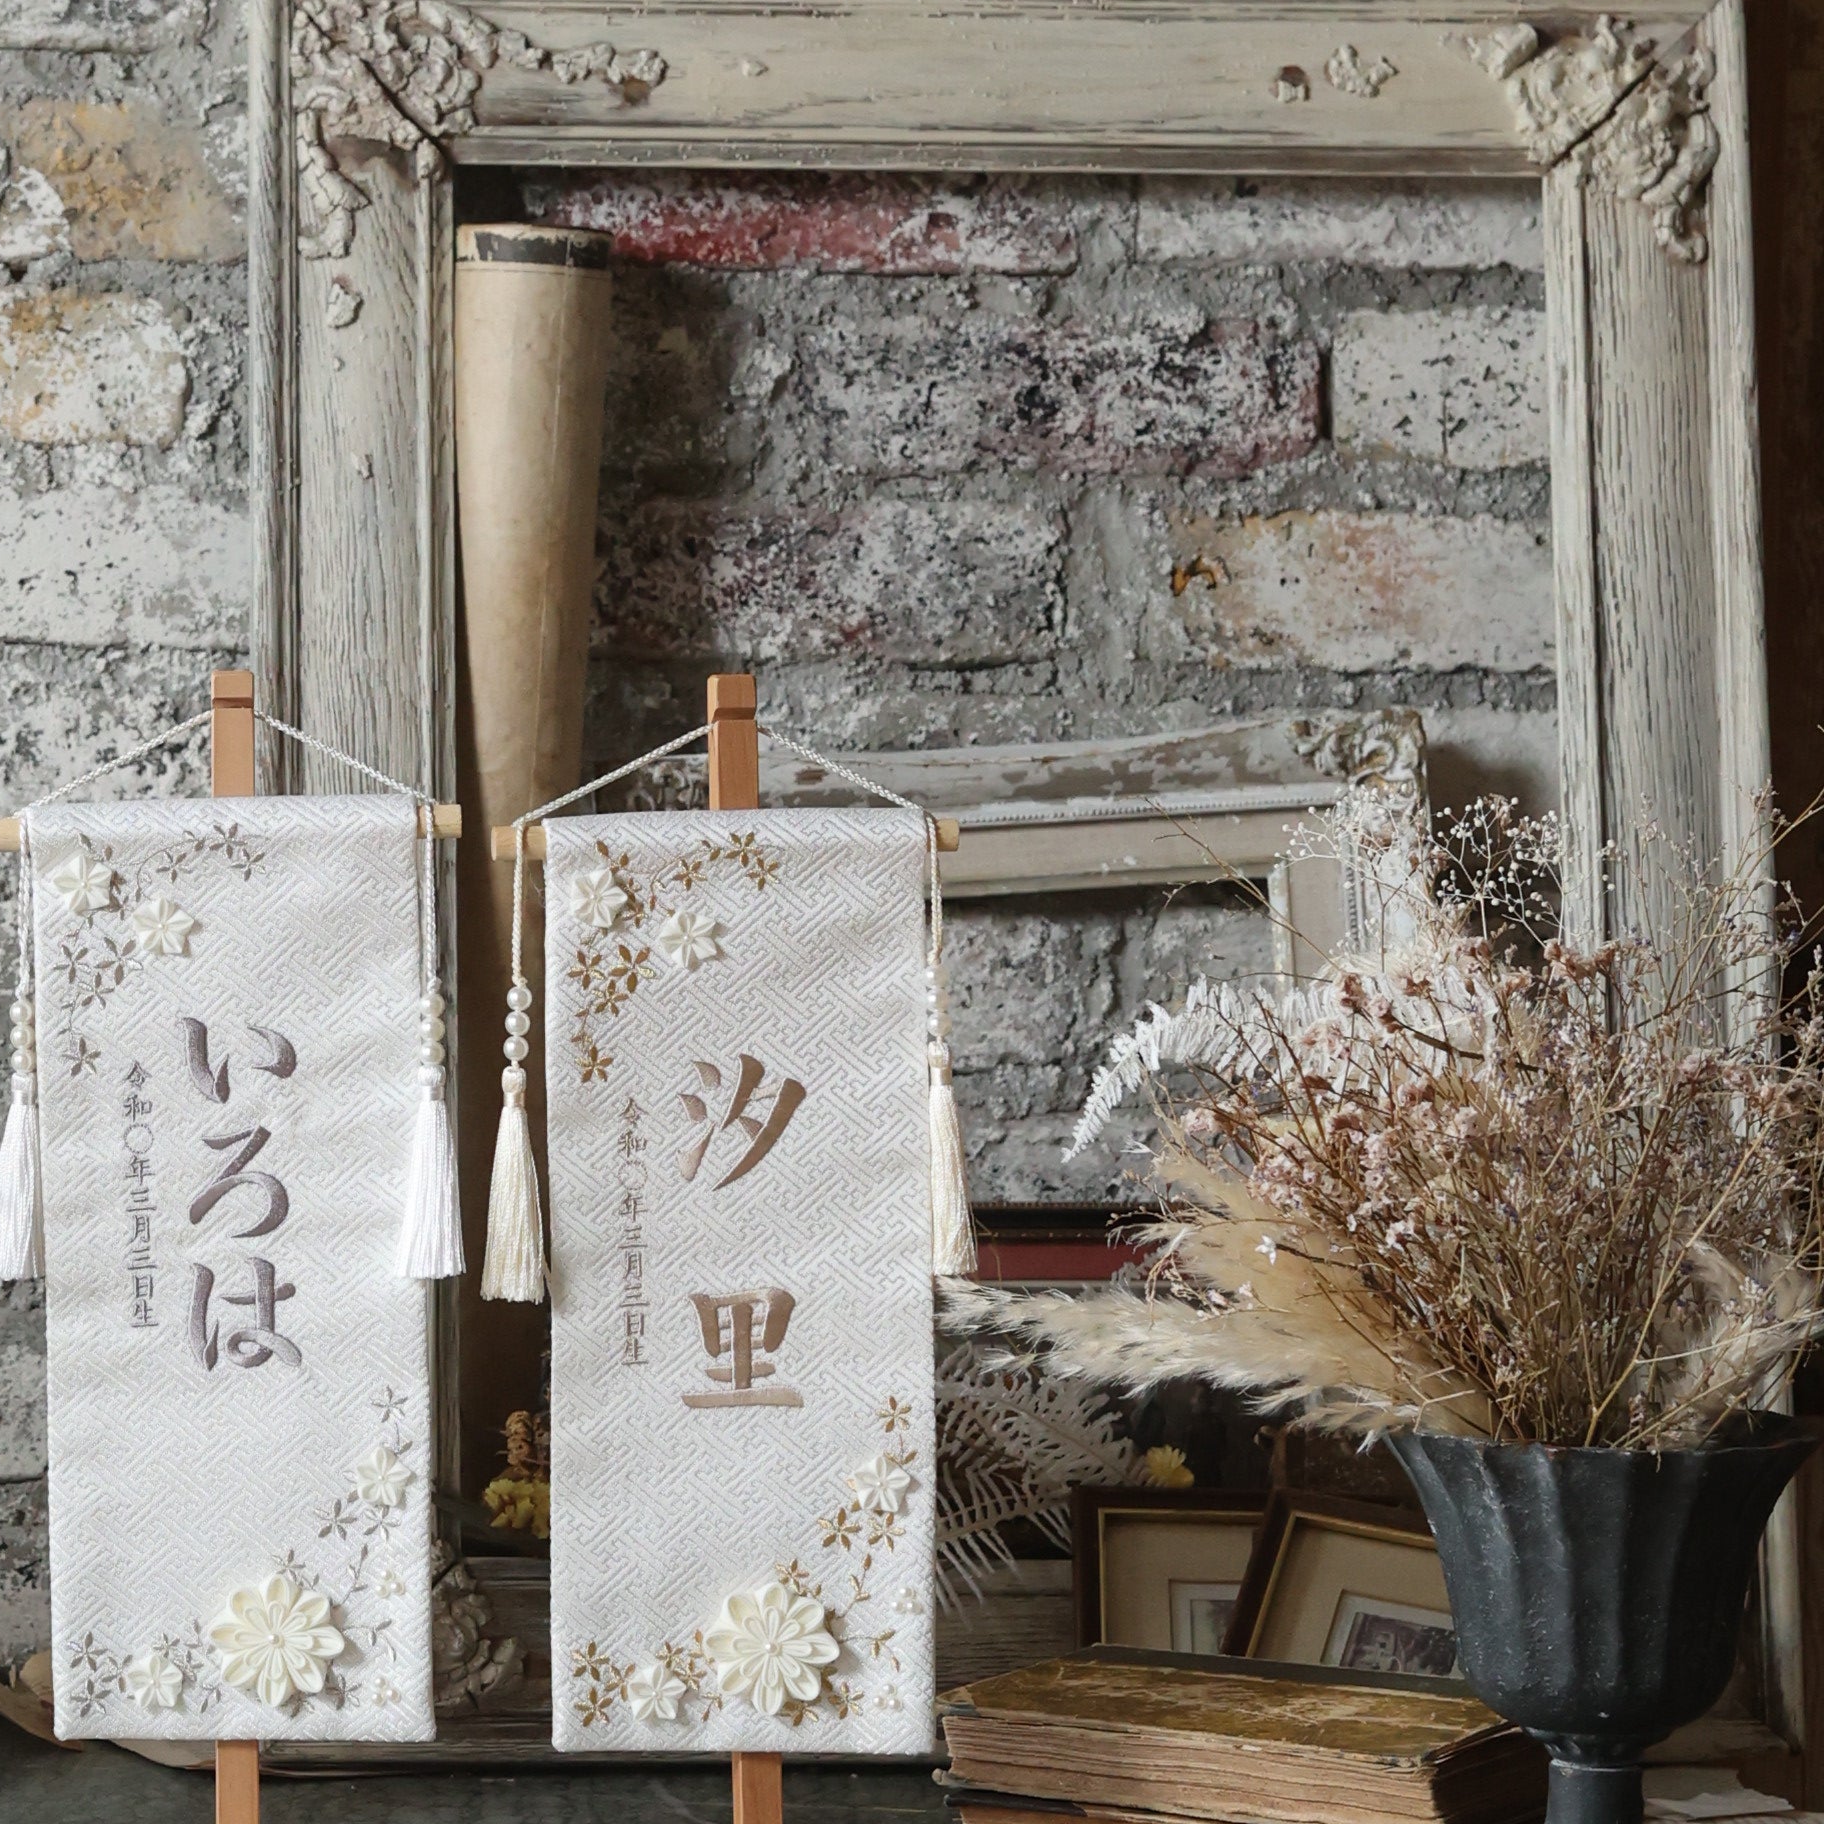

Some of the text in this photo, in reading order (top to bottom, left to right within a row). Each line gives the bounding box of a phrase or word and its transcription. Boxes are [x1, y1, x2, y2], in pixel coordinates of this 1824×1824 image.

[182, 1016, 303, 1372] いろは
[677, 1053, 807, 1409] 汐里
